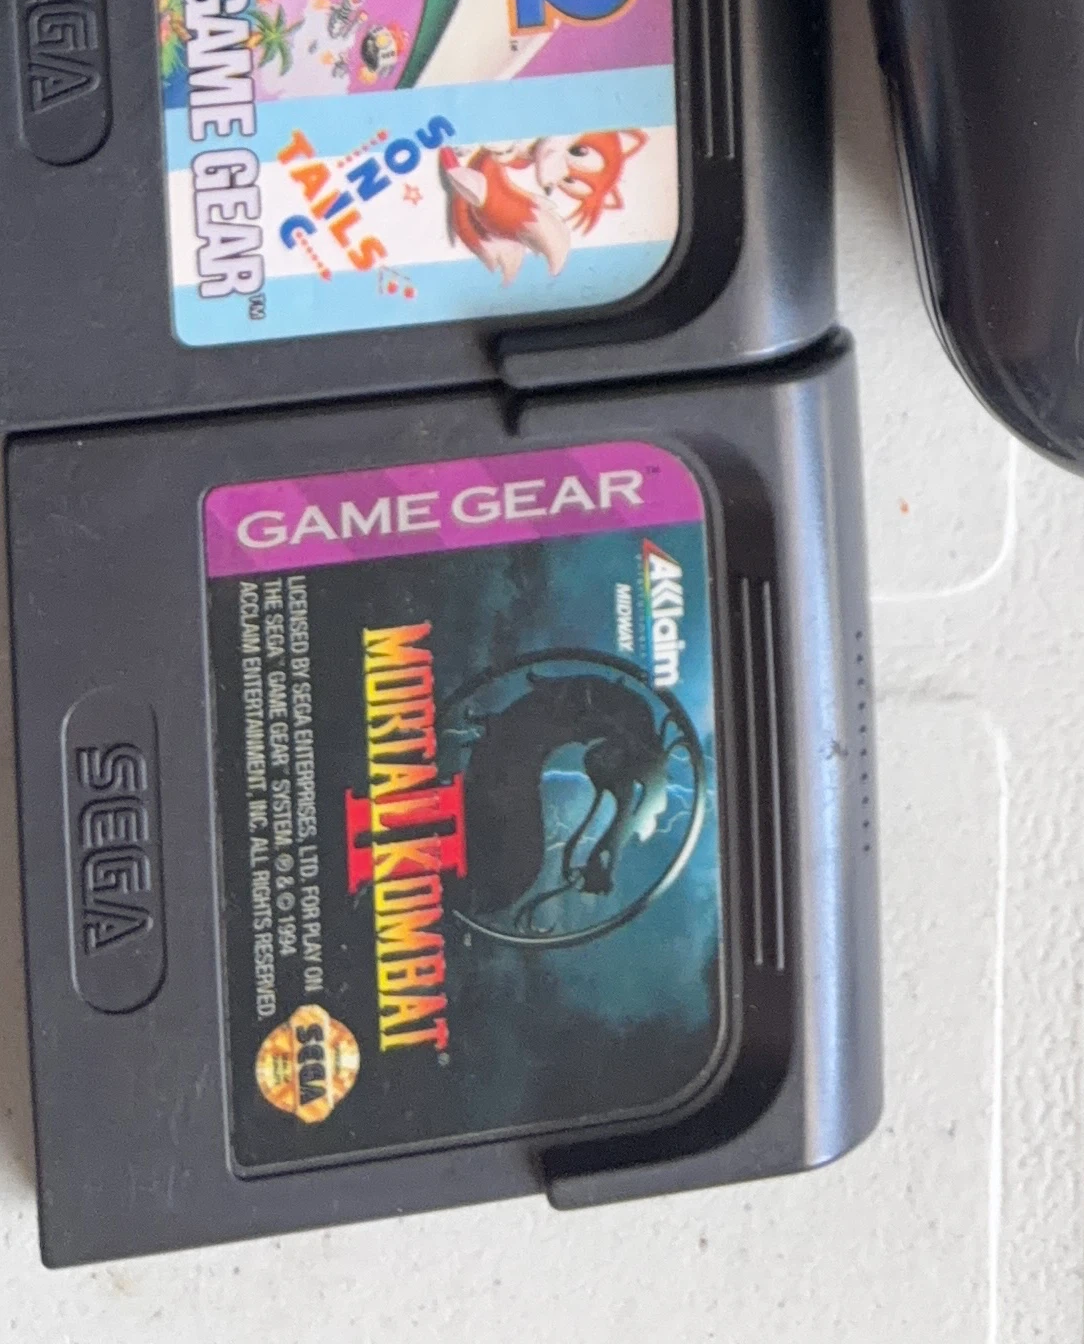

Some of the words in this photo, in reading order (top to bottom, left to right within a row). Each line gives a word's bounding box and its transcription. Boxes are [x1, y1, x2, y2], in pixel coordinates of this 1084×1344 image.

[192, 147, 265, 299] GEAR
[277, 129, 388, 272] TAILS
[237, 491, 440, 549] GAME
[451, 469, 645, 525] GEAR
[239, 581, 260, 654] ACCLAIM
[263, 578, 284, 611] THE
[288, 575, 309, 654] LICENSED
[615, 582, 635, 652] MIDWAY
[267, 671, 287, 719] GAME
[291, 656, 310, 679] BY
[242, 657, 267, 798] ENTERTAINMENT,
[292, 682, 312, 727] SEGA
[363, 620, 438, 832] MORTAL
[248, 800, 268, 833] INC.
[272, 779, 293, 851] SYSTEM.
[293, 729, 317, 843] ENTERPRISES,
[76, 742, 153, 956] SEGA
[250, 836, 269, 869] ALL
[299, 844, 319, 883] LTD.
[251, 870, 272, 930] RIGHTS
[278, 914, 297, 957] 1994
[300, 885, 320, 920] FOR
[254, 931, 277, 1021] RESERVED.
[302, 922, 322, 963] PLAY
[372, 833, 449, 1052] KOMBAT
[304, 965, 323, 992] ON
[295, 1022, 327, 1105] SEGA
